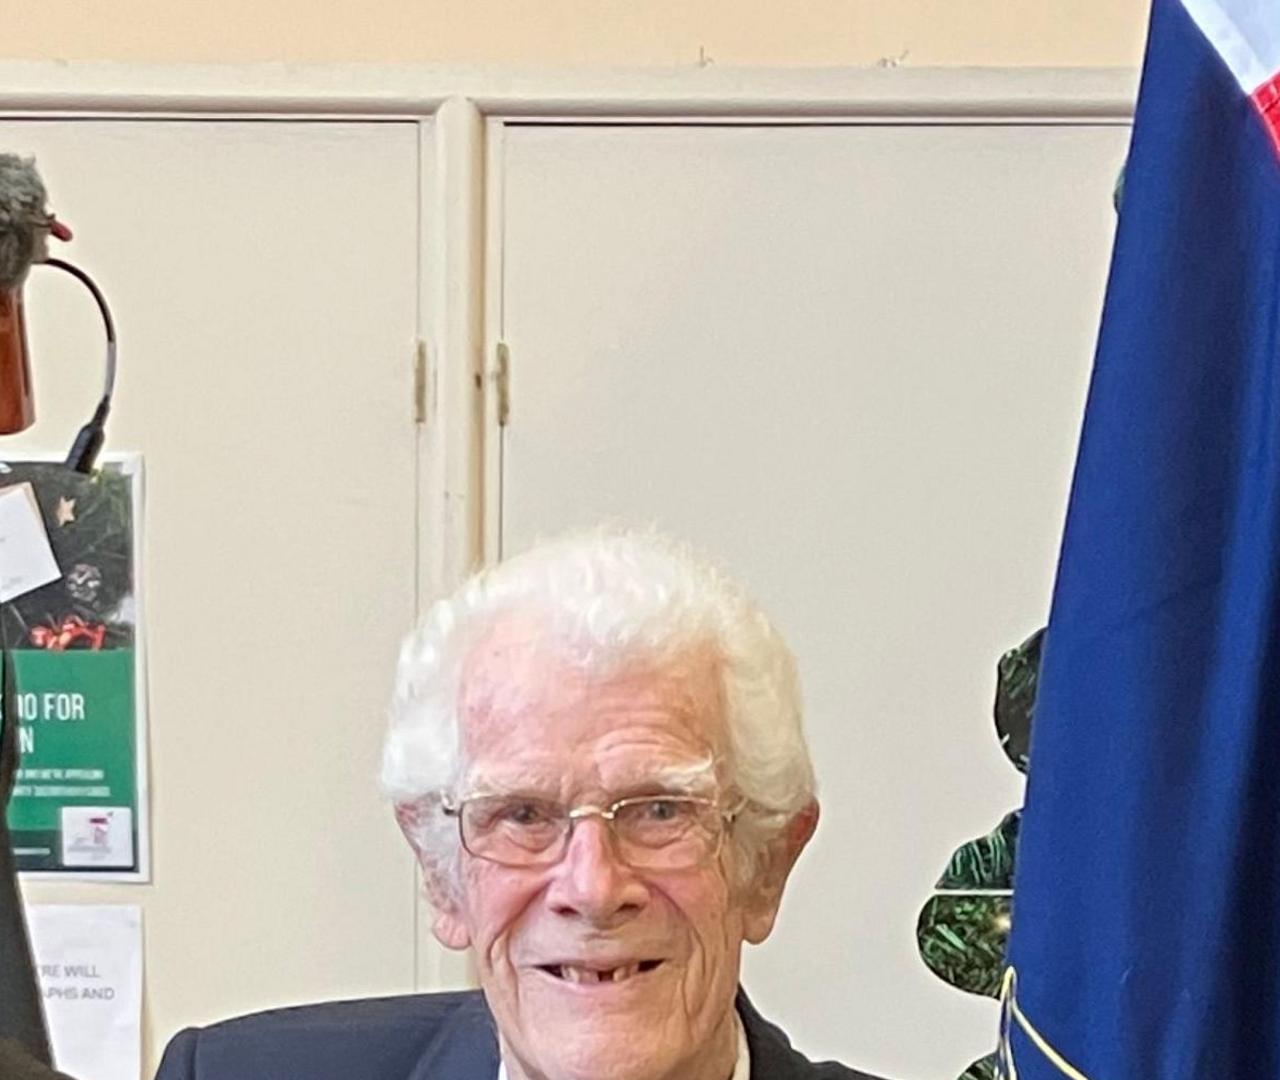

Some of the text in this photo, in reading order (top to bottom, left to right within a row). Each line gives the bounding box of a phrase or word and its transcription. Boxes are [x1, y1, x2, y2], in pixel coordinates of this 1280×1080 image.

[43, 693, 85, 721] FOR
[64, 964, 101, 978] WILL
[82, 986, 115, 1000] AND
